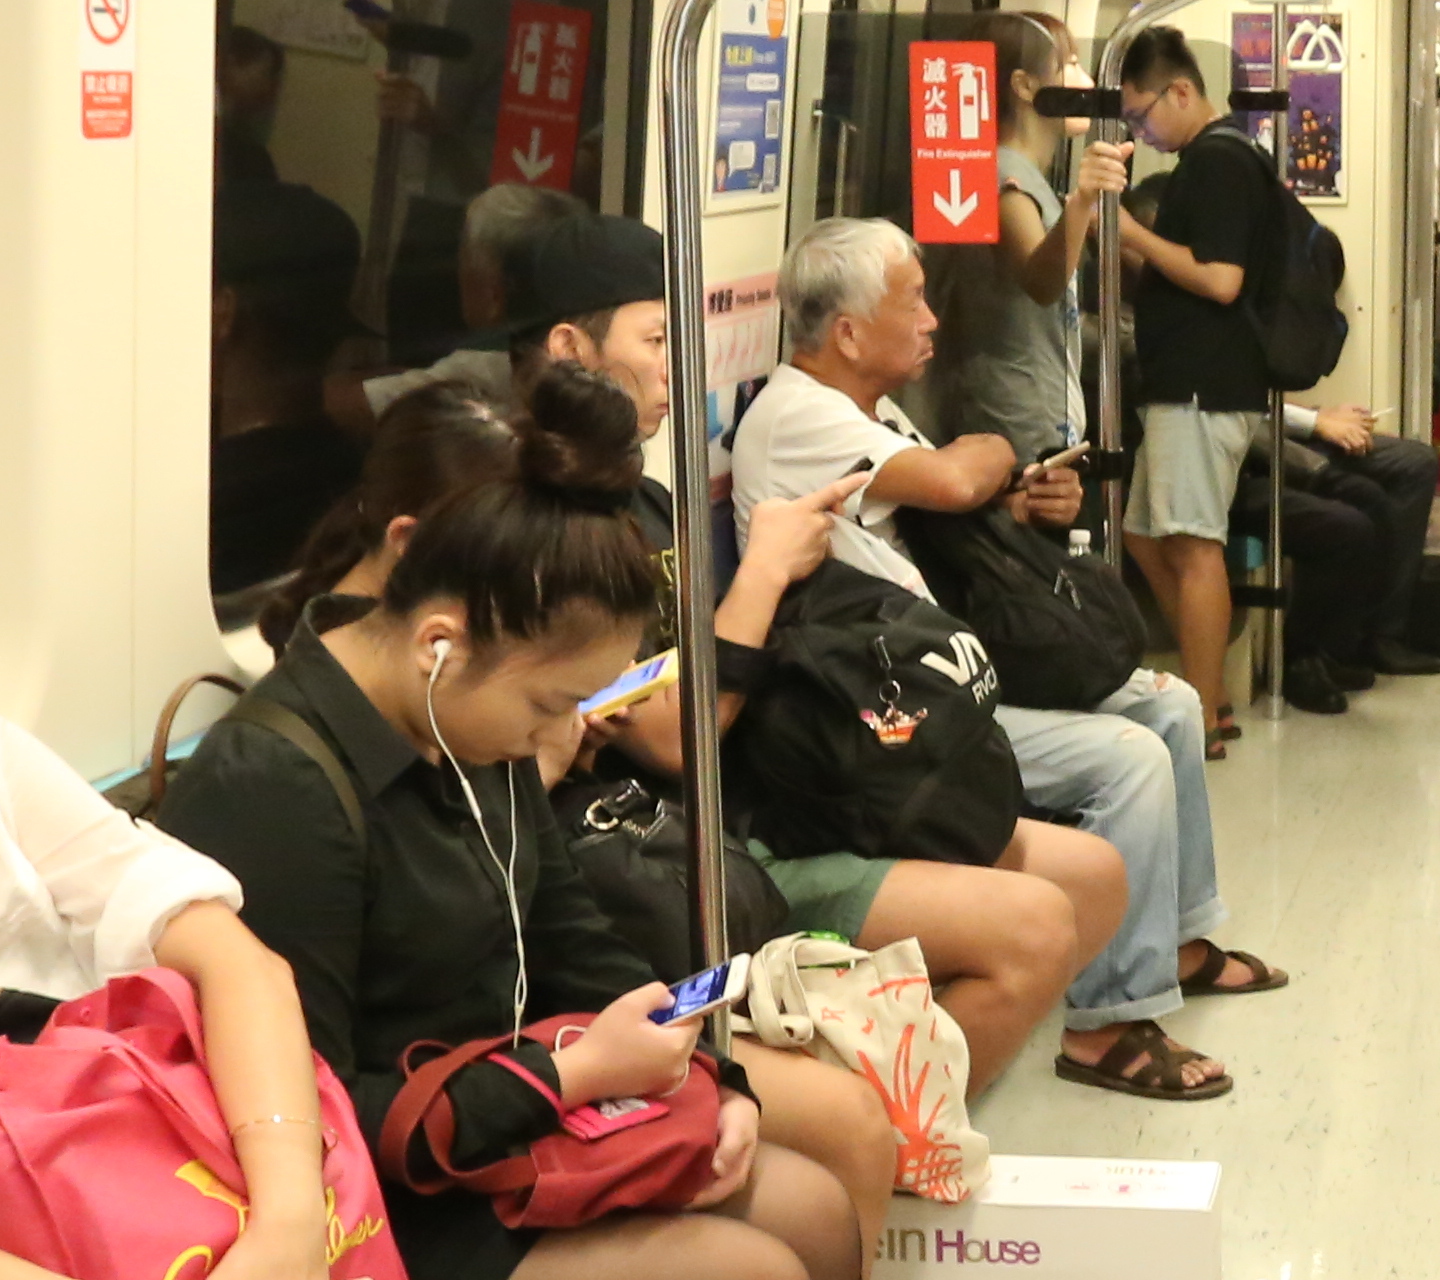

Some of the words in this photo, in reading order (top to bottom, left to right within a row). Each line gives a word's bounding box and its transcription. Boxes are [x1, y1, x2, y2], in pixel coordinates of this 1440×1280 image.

[922, 57, 948, 139] 滅火器
[916, 148, 934, 159] Fire
[936, 148, 993, 161] Extinguisher
[935, 1228, 1041, 1265] House
